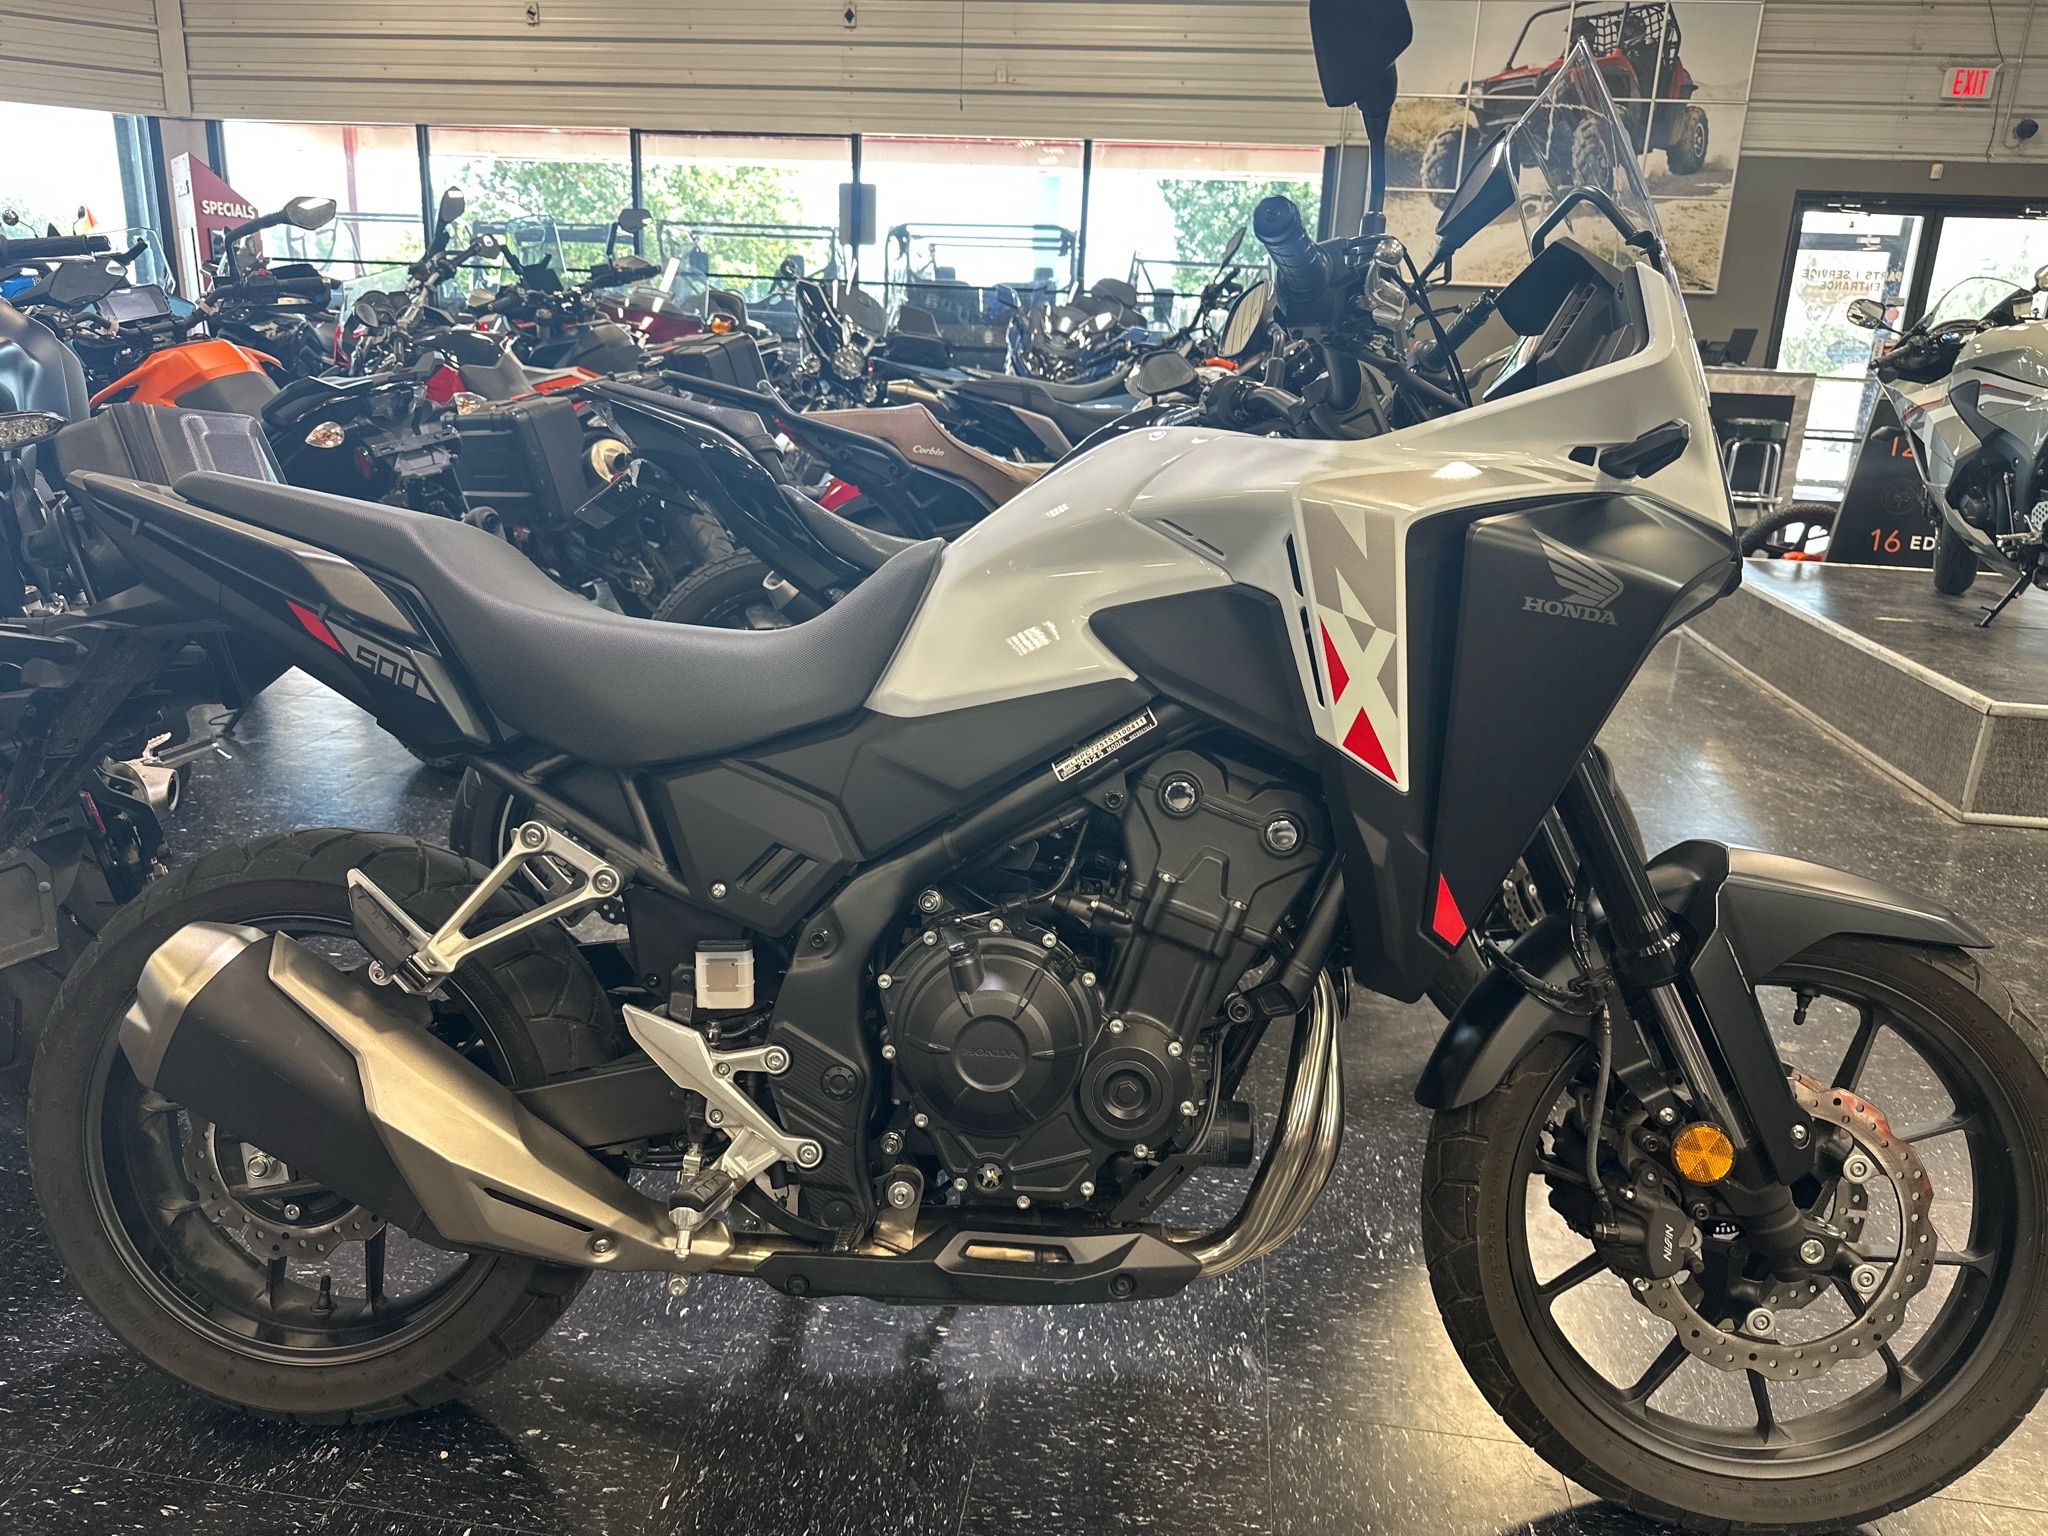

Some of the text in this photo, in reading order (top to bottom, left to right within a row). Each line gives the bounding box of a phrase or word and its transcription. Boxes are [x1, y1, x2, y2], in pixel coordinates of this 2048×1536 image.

[1952, 69, 1990, 95] EXIT
[201, 199, 256, 220] SPECIALS
[912, 444, 945, 457] Corbin
[1871, 528, 1901, 553] 16
[1521, 596, 1619, 626] HONDA
[1300, 500, 1400, 786] NX
[355, 644, 420, 695] 500
[1078, 751, 1105, 769] 2025
[1106, 739, 1127, 754] MODEL
[961, 1047, 1020, 1059] HONDA
[1662, 1223, 1675, 1263] NISSIN
